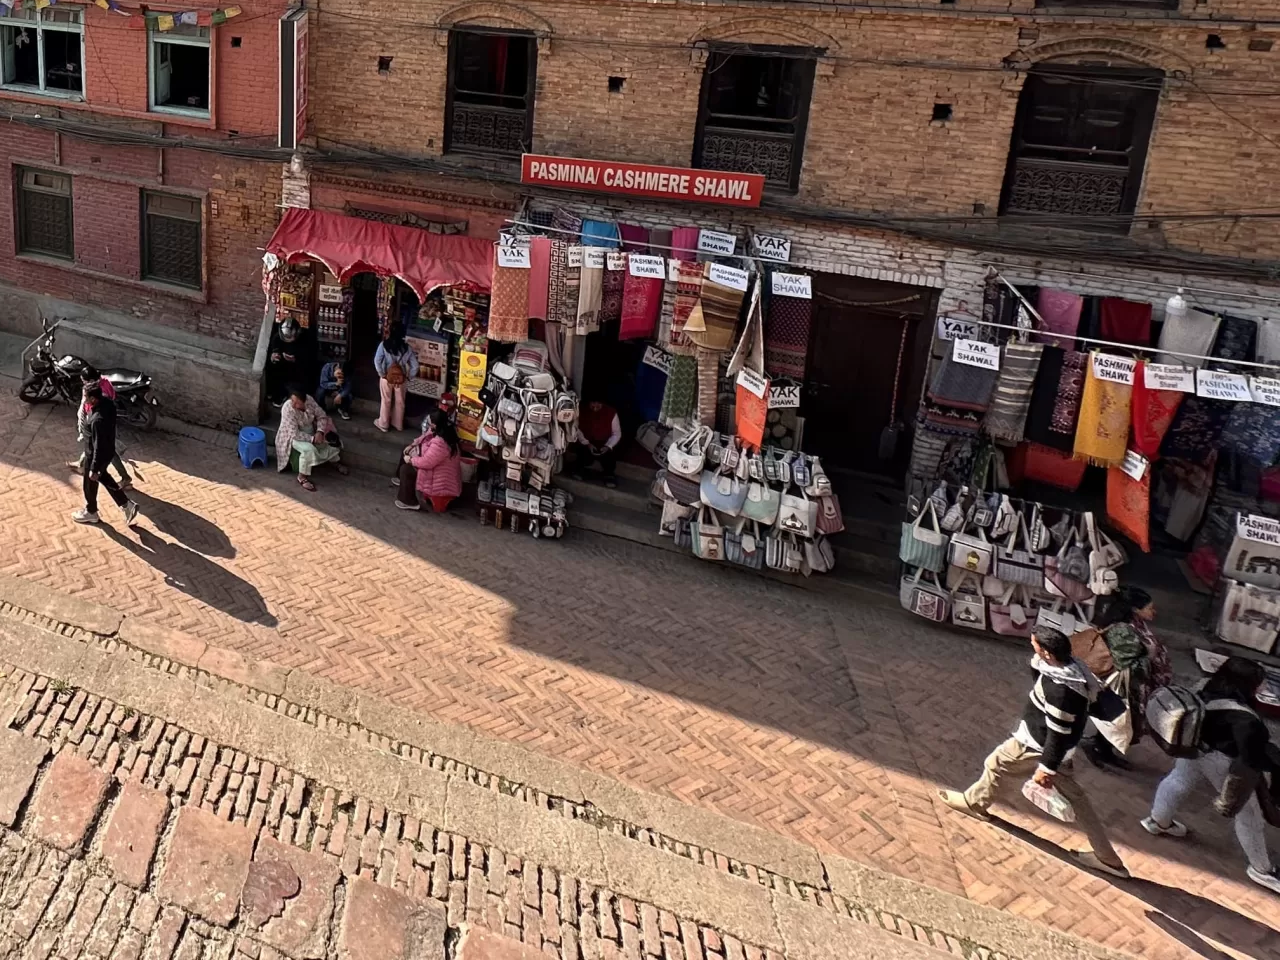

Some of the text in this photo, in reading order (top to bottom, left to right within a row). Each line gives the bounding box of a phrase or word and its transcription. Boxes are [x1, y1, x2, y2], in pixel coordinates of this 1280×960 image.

[530, 161, 752, 201] PASMINA/ CASHMERE SHAWL
[701, 241, 730, 253] SHAWL
[756, 235, 788, 251] YAK
[502, 248, 525, 257] YAK
[631, 257, 664, 267] PASHMINA
[636, 266, 659, 275] SHAWL
[711, 267, 747, 281] PASHMINA
[716, 274, 741, 285] SHAWL
[781, 275, 802, 284] YAK
[773, 283, 811, 296] SHAWL
[942, 321, 974, 335] YAK
[968, 343, 988, 353] YAK
[650, 348, 674, 367] YAK
[957, 352, 995, 367] SHAWAL
[1099, 368, 1130, 382] SHAWL
[1159, 381, 1179, 389] Shawl
[1199, 379, 1246, 392] PASHMINA
[769, 386, 798, 398] YAK
[1206, 389, 1243, 399] SHAWL
[770, 399, 797, 407] SHAWL
[1246, 528, 1280, 544] SHAWL
